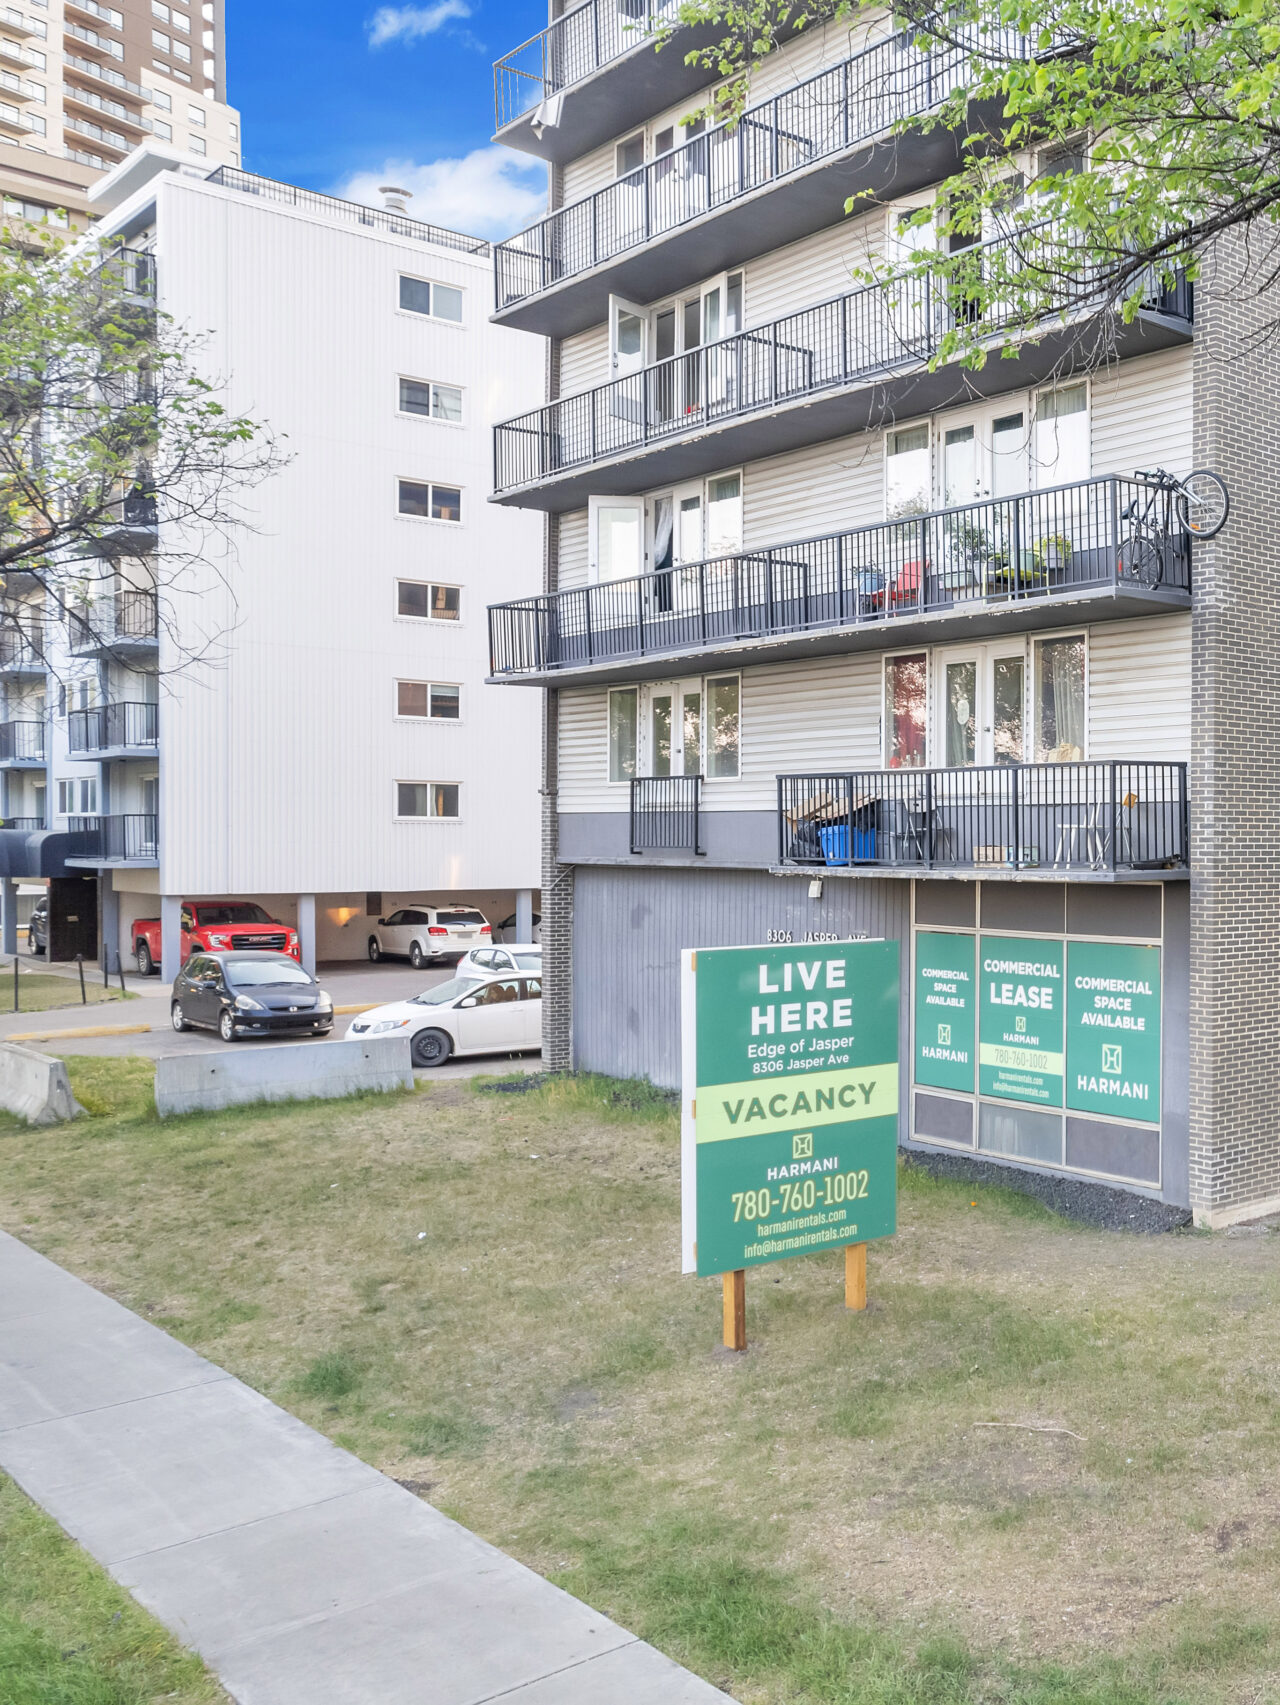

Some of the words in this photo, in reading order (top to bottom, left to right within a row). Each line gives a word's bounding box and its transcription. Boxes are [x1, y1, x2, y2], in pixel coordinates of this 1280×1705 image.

[767, 929, 792, 943] 8306
[758, 959, 846, 994] LIVE
[922, 968, 969, 981] COMMERCIAL
[984, 959, 1060, 978] COMMERCIAL
[933, 982, 957, 993] SPACE
[990, 982, 1053, 1010] LEASE
[1075, 976, 1152, 995] COMMERCIAL
[926, 995, 965, 1008] AVAILABLE
[1094, 995, 1132, 1011] SPACE
[751, 998, 853, 1036] HERE
[1081, 1012, 1145, 1031] AVAILABLE
[747, 1043, 785, 1060] Edge
[789, 1039, 806, 1054] of
[808, 1036, 854, 1055] Jasper
[1003, 1032, 1039, 1046] HARMANI
[752, 1060, 784, 1074] 8306
[787, 1056, 824, 1072] Jasper
[828, 1054, 849, 1066] Ave
[922, 1046, 968, 1063] HARMANI
[995, 1048, 1048, 1070] 780-760-1002
[1077, 1074, 1149, 1100] HARMANI
[722, 1081, 877, 1125] VACANCY
[767, 1157, 838, 1181] HARMANI
[731, 1170, 868, 1223] 780-760-1002
[757, 1209, 846, 1238] harmanirentals.com
[744, 1223, 857, 1258] info@harmanirentals.com
